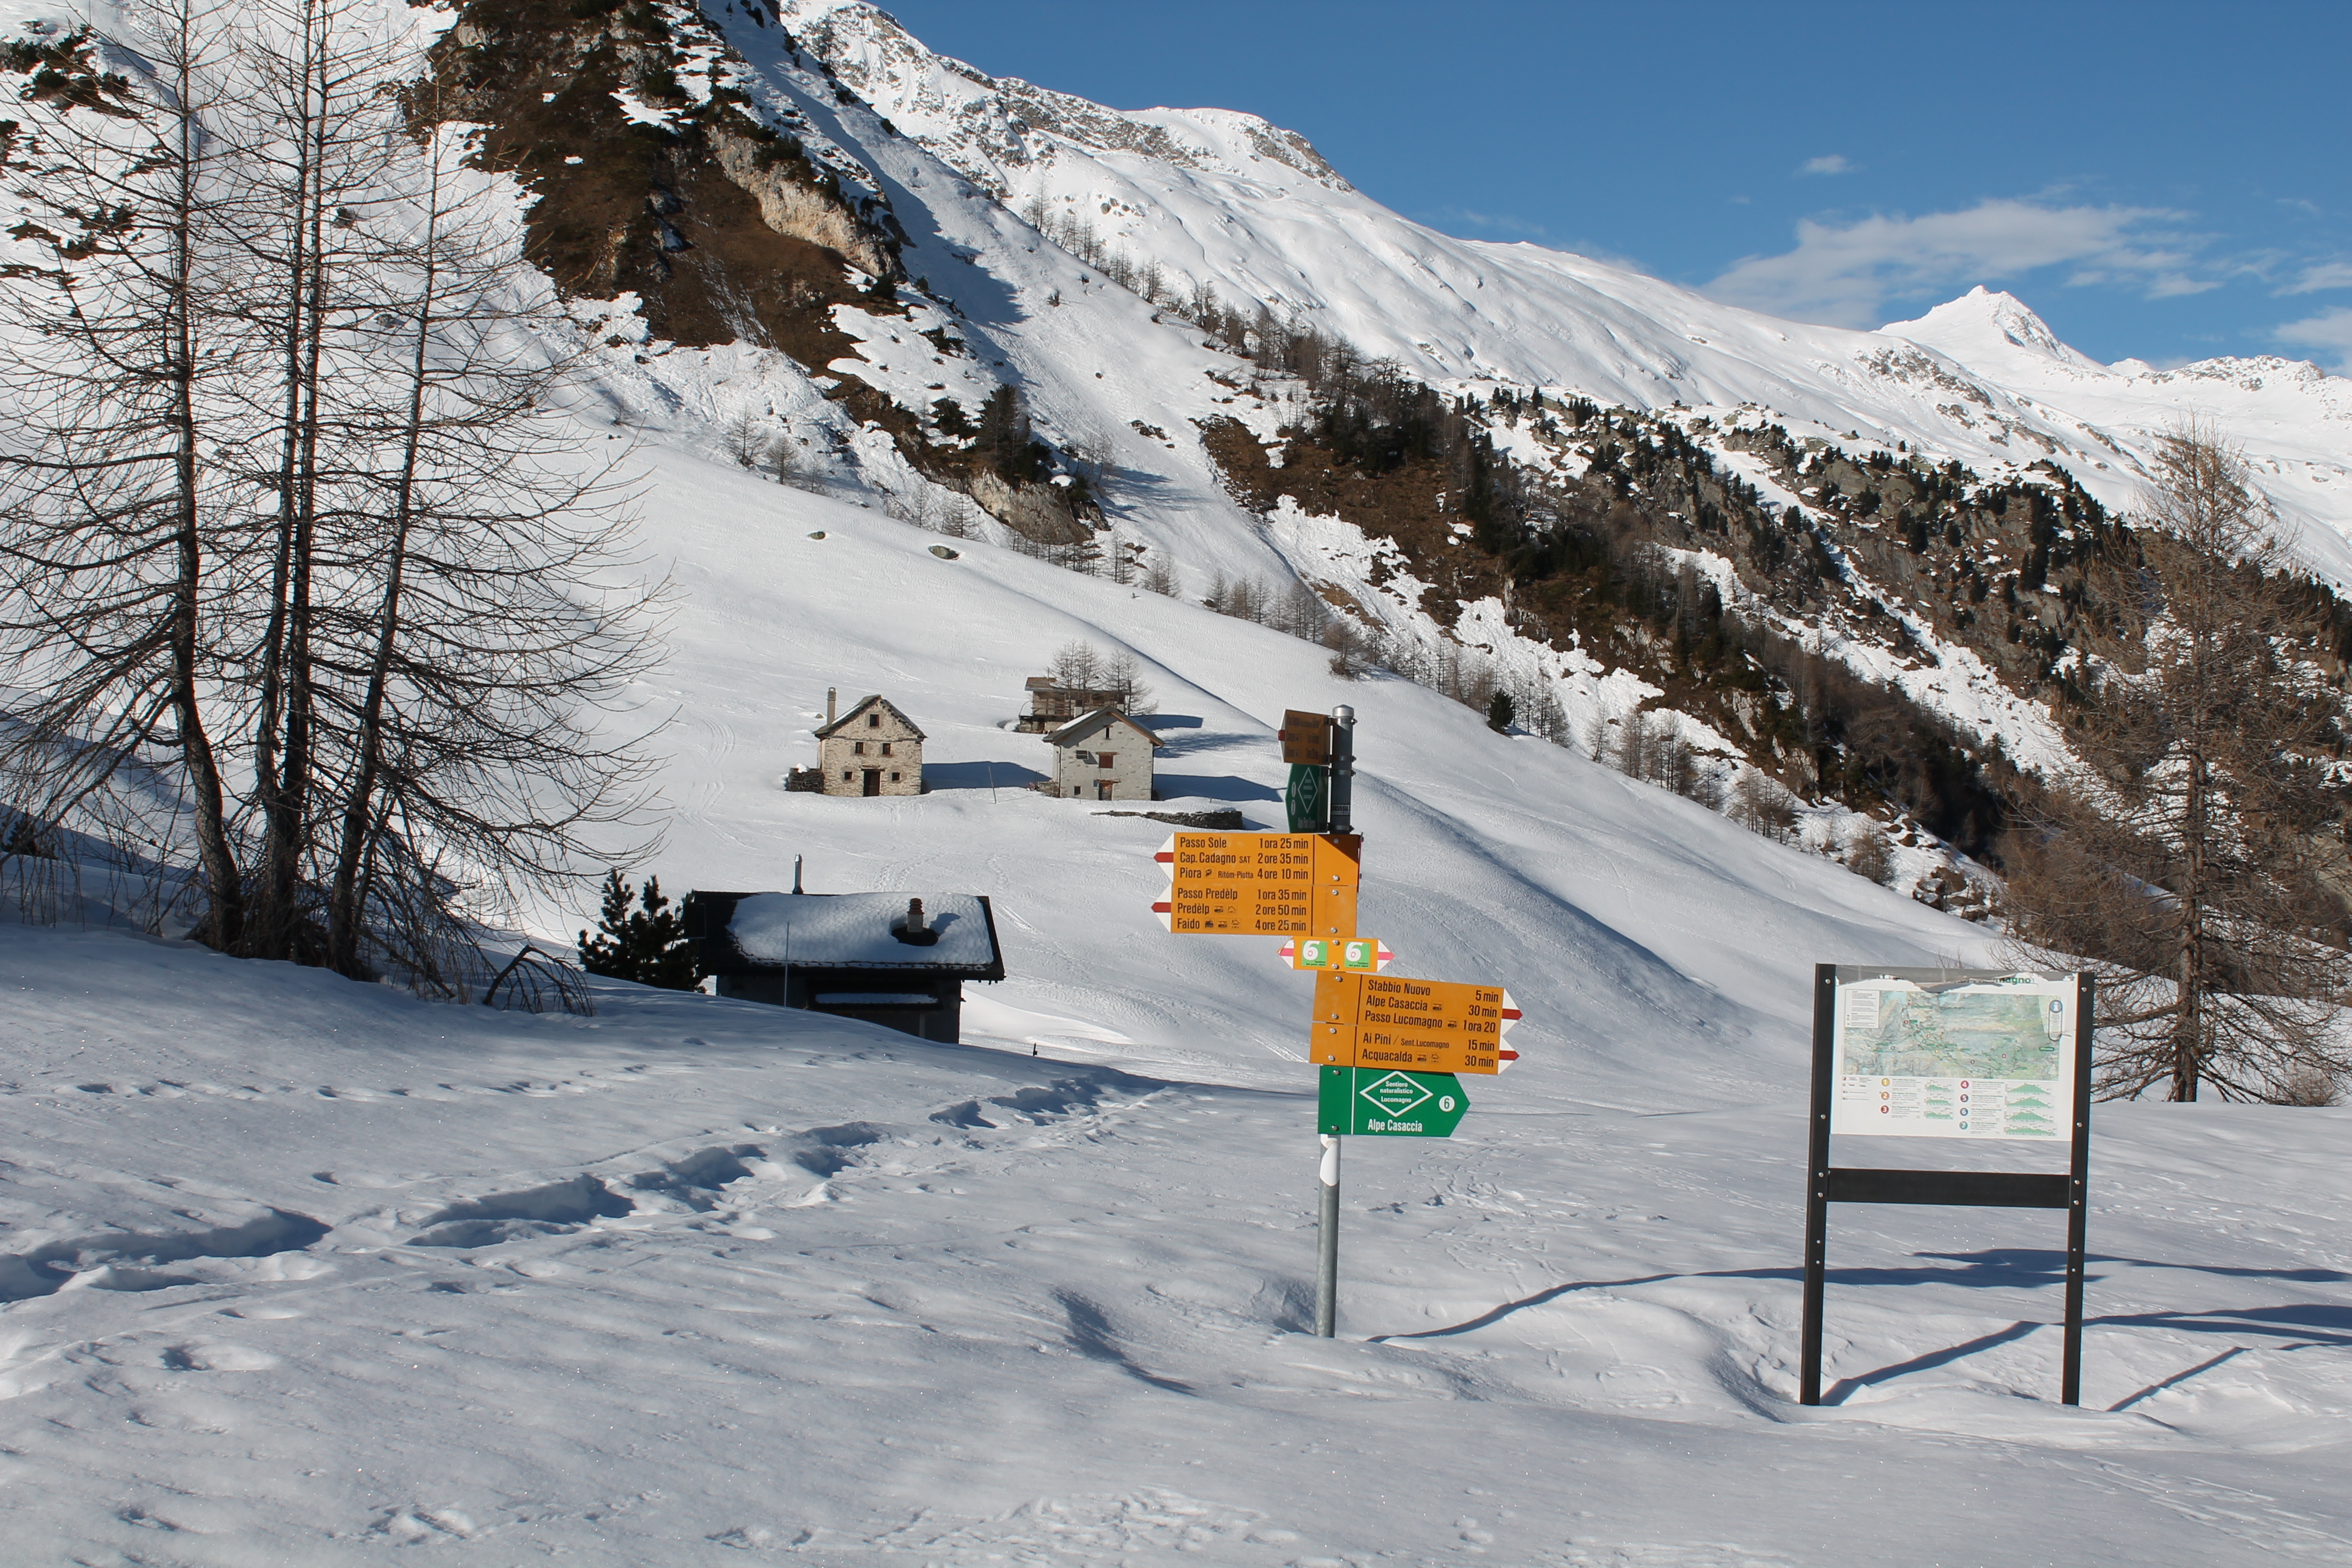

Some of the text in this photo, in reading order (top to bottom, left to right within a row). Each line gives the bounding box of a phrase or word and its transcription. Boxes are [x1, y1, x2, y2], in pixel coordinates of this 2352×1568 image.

[1180, 836, 1309, 849] Passo Sole 1 ora 25 min
[1180, 852, 1308, 865] Cap. Cadagno SAT 2 ore 35 min
[1180, 867, 1202, 879] Piora
[1257, 868, 1263, 879] 4
[1264, 870, 1278, 880] ore
[1282, 868, 1291, 880] 10
[1293, 869, 1308, 880] min
[1178, 888, 1306, 901] Passo Predèlp 1 ora 35 min
[1177, 902, 1306, 916] Predèlp 2 ore 50 min
[1177, 918, 1306, 931] Faido 4 ore 25 min
[1303, 940, 1320, 961] 6
[1346, 942, 1363, 962] 6
[1368, 979, 1499, 1003] Stabbio Nuovo 5 min
[1366, 994, 1498, 1018] Alpe Casaccia 30 min
[1365, 1010, 1496, 1033] Passo Lucomagno 1 ora 20
[1363, 1032, 1372, 1044] Ai
[1374, 1033, 1391, 1045] Pini
[1401, 1038, 1416, 1047] Sent.
[1416, 1039, 1450, 1049] Lucomagno
[1468, 1039, 1478, 1050] 15
[1480, 1040, 1495, 1052] min
[1362, 1048, 1494, 1068] Acquacalda 30 min
[1444, 1097, 1450, 1109] 6
[1368, 1119, 1423, 1133] Alpe Casaccia
